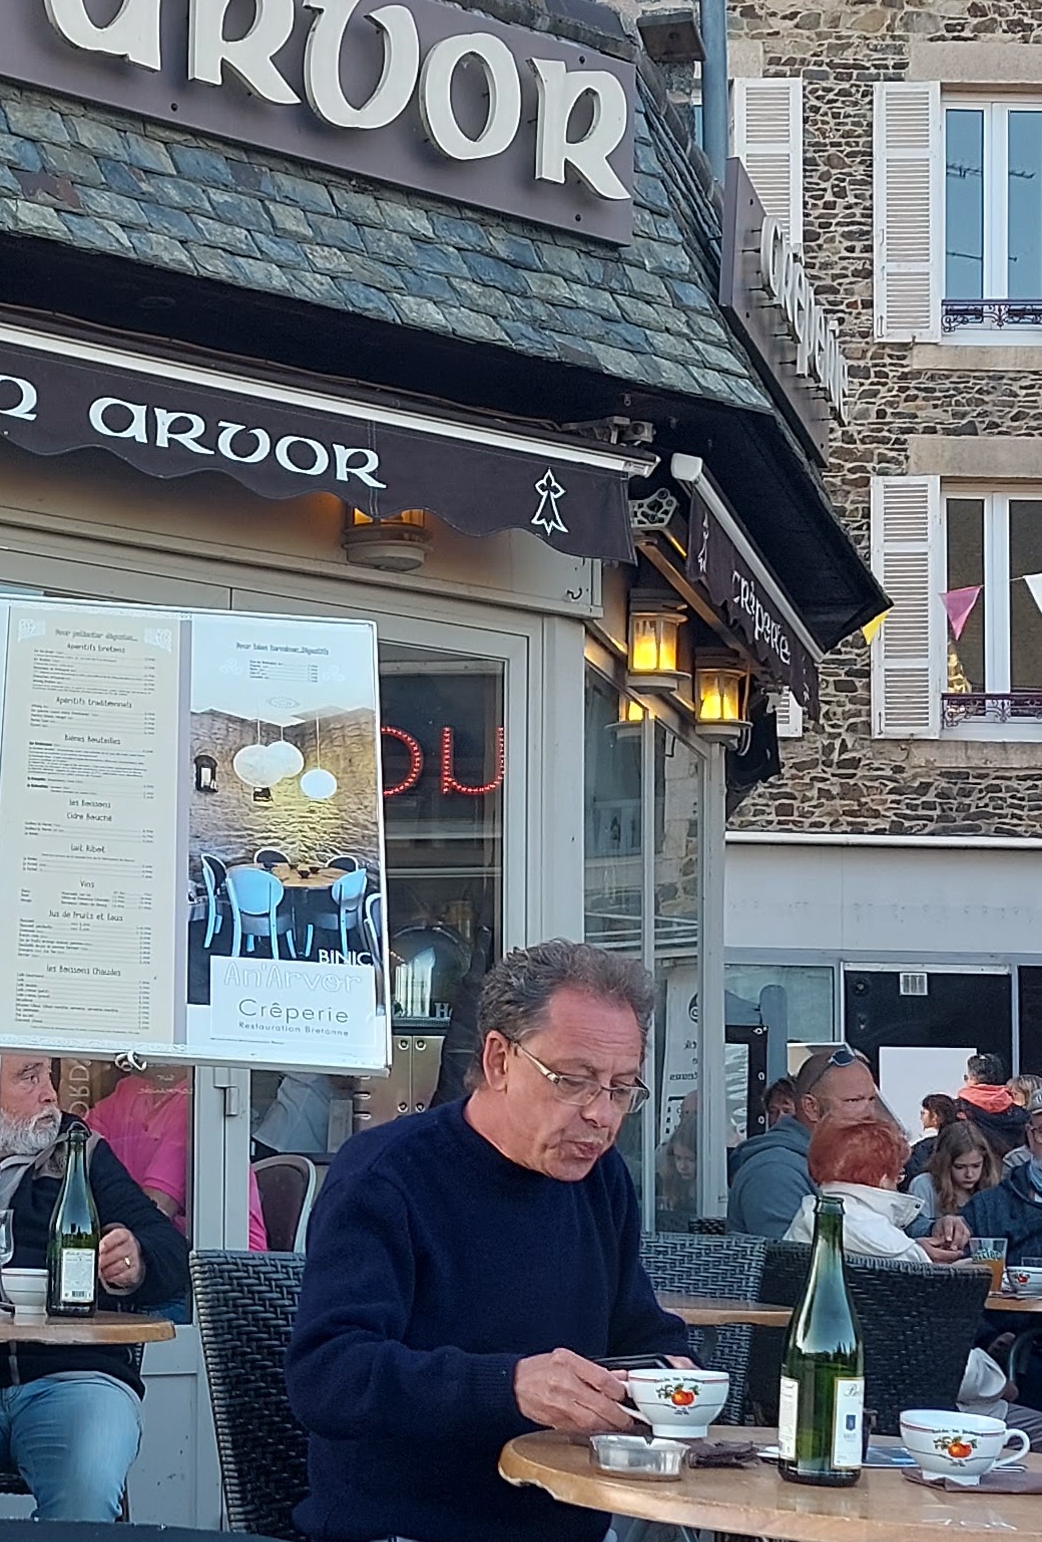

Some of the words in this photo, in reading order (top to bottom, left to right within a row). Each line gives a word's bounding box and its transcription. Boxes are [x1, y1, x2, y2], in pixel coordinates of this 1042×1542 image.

[238, 998, 349, 1024] Crêperie
[238, 1021, 301, 1033] Restauration
[305, 1026, 349, 1037] Bretonne
